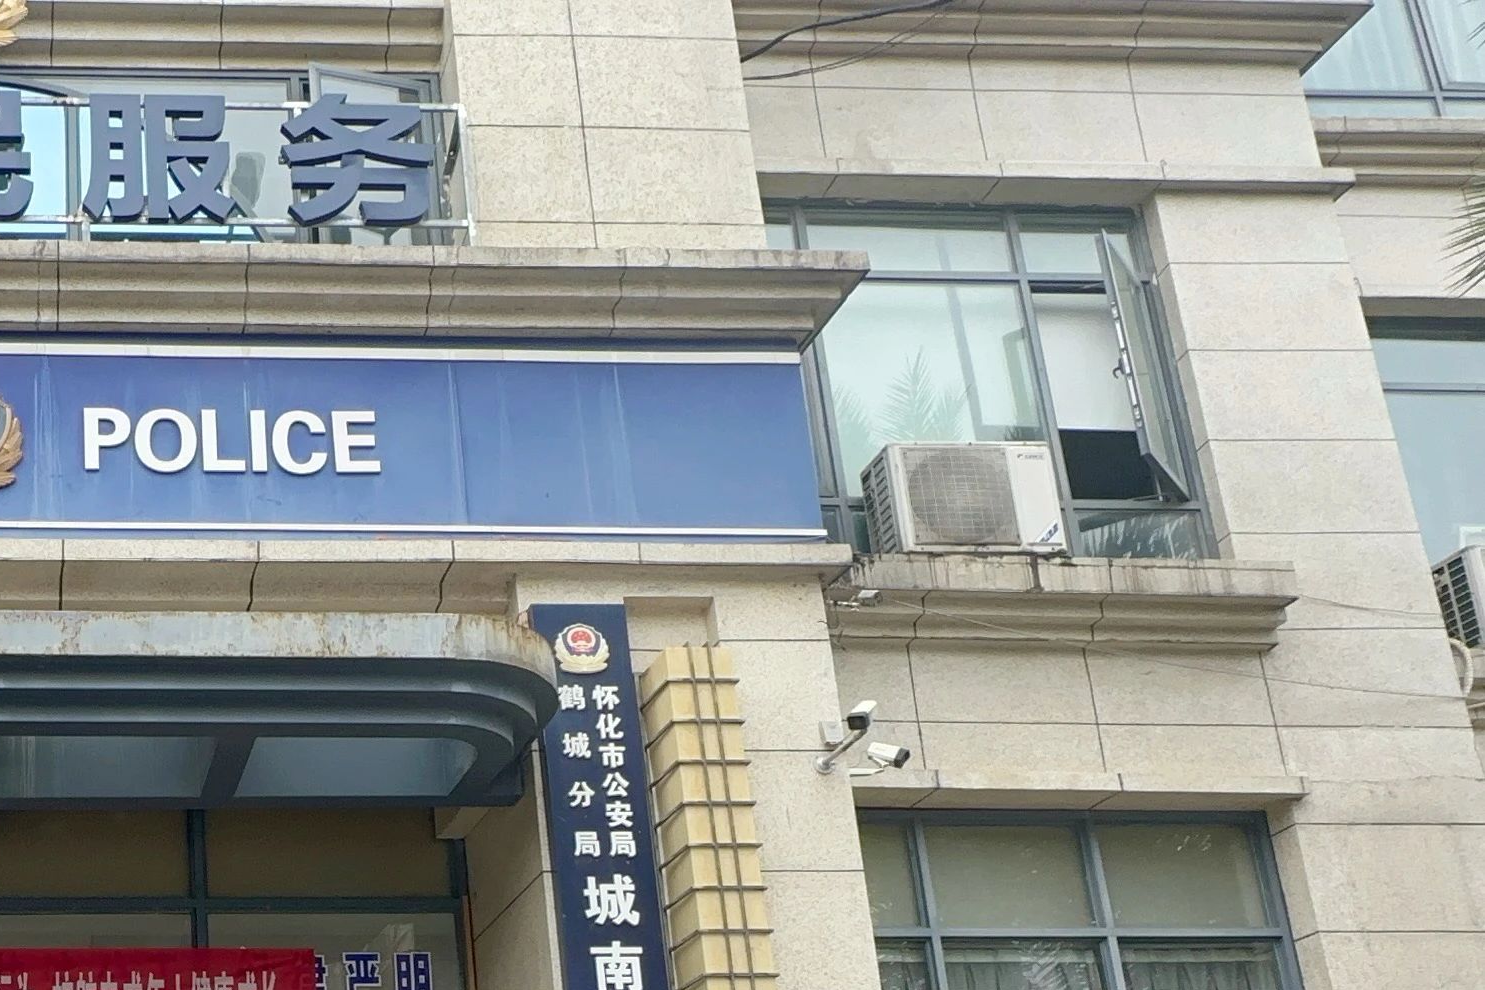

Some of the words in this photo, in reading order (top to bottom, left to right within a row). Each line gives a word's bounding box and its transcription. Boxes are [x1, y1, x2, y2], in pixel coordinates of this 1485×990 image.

[82, 406, 382, 475] POLICE
[557, 684, 601, 858] 鹤城分局
[592, 684, 637, 857] 怀化市公安局
